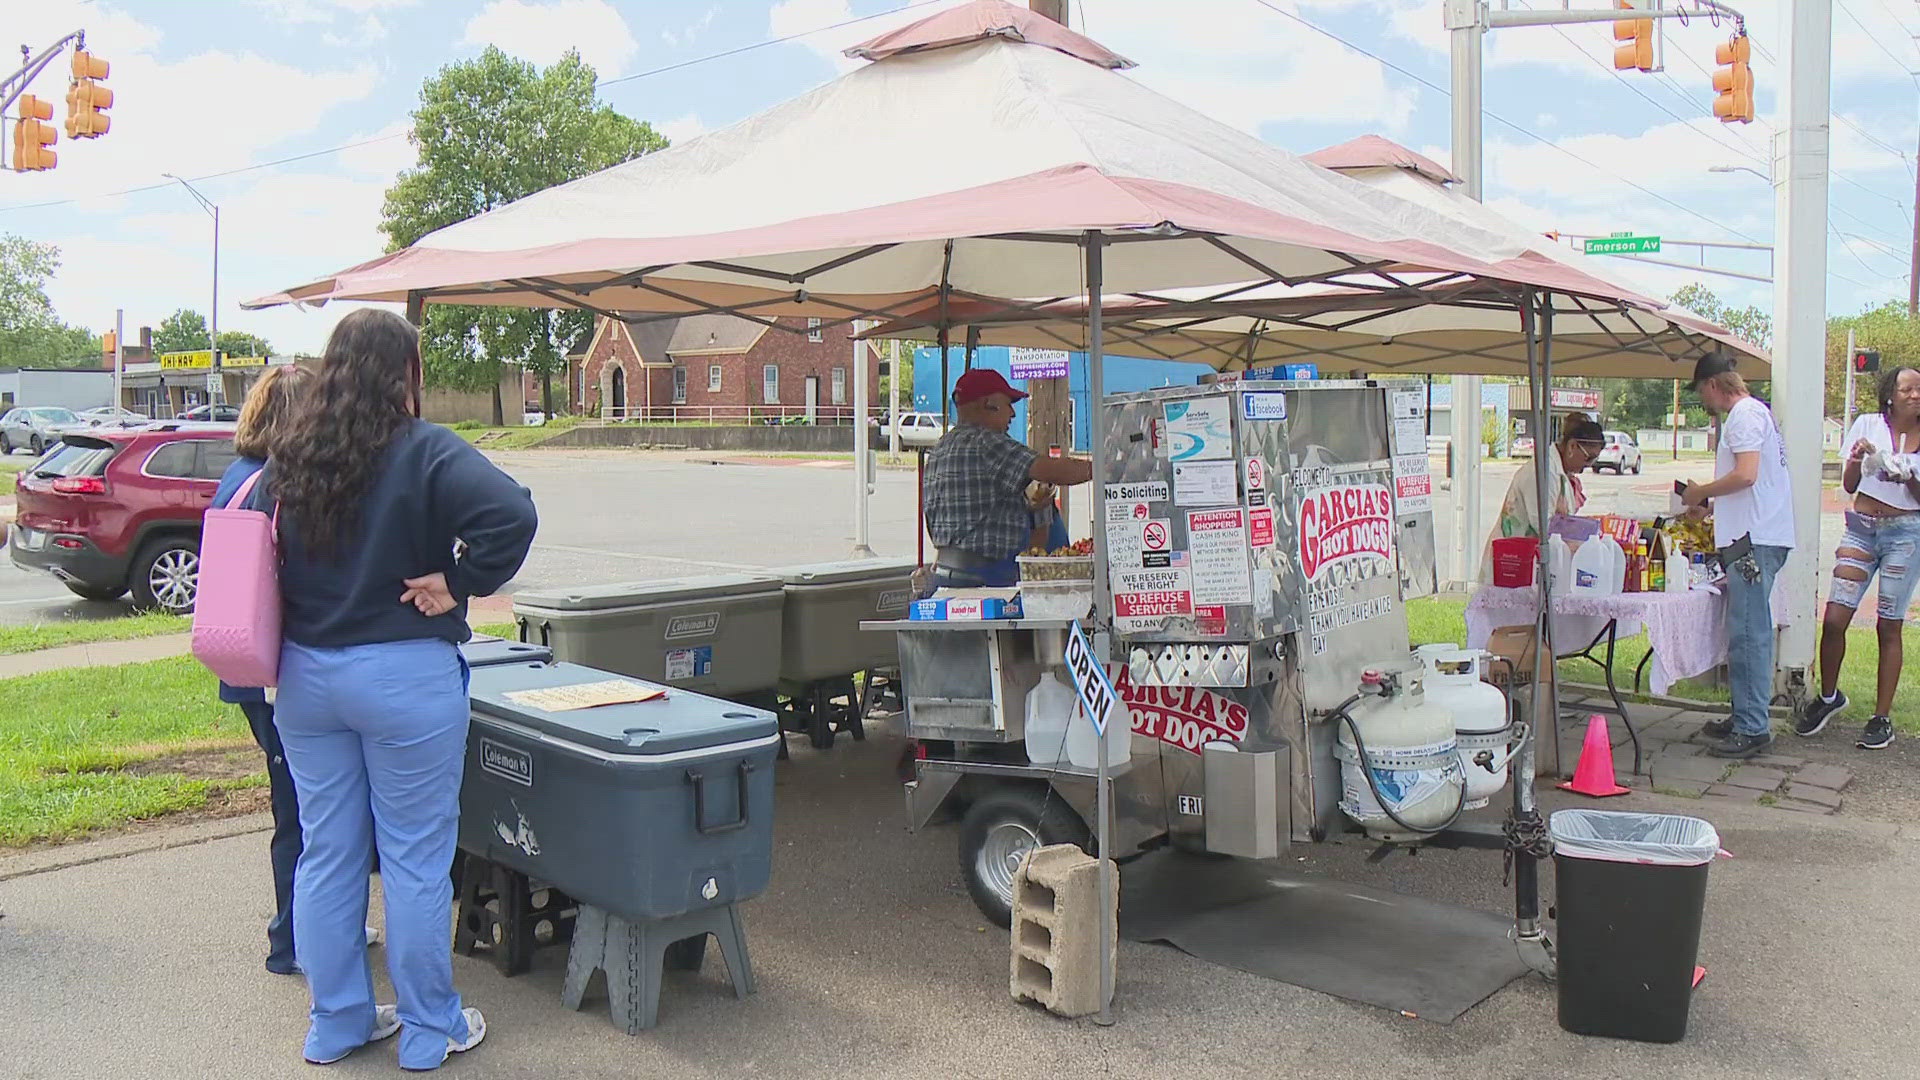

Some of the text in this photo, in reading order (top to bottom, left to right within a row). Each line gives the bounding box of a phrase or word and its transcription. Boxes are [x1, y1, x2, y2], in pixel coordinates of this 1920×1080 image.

[1586, 240, 1658, 252] Emerson Av
[1012, 352, 1066, 362] TRANSPORTATION
[1256, 404, 1283, 414] facebook
[1407, 475, 1429, 486] REFUSE
[1104, 485, 1167, 500] No Soliciting
[1402, 485, 1426, 497] SERVICE
[1193, 511, 1237, 521] ATTENTION
[1194, 520, 1237, 530] SHOPPERS
[1195, 532, 1213, 540] CASH
[1300, 488, 1390, 579] GARCIA'S
[1321, 521, 1388, 560] HOT DOGS
[1122, 572, 1179, 583] WE RESERVE
[1127, 581, 1175, 591] THE RIGHT
[1120, 595, 1137, 605] TO
[1140, 592, 1184, 603] REFUSE
[1129, 604, 1178, 616] SERVICE
[1310, 611, 1334, 634] THANK
[1336, 606, 1350, 627] YOU
[1351, 602, 1368, 622] HAVE
[1375, 596, 1391, 616] NICE
[672, 619, 707, 632] Coleman
[1130, 619, 1143, 628] TO
[1312, 635, 1326, 655] DAY
[1070, 635, 1110, 724] OPEN
[1107, 664, 1249, 732] ARCIA'S
[1132, 708, 1233, 749] OT DOG
[485, 744, 519, 772] Coleman
[1180, 797, 1200, 814] FRI
